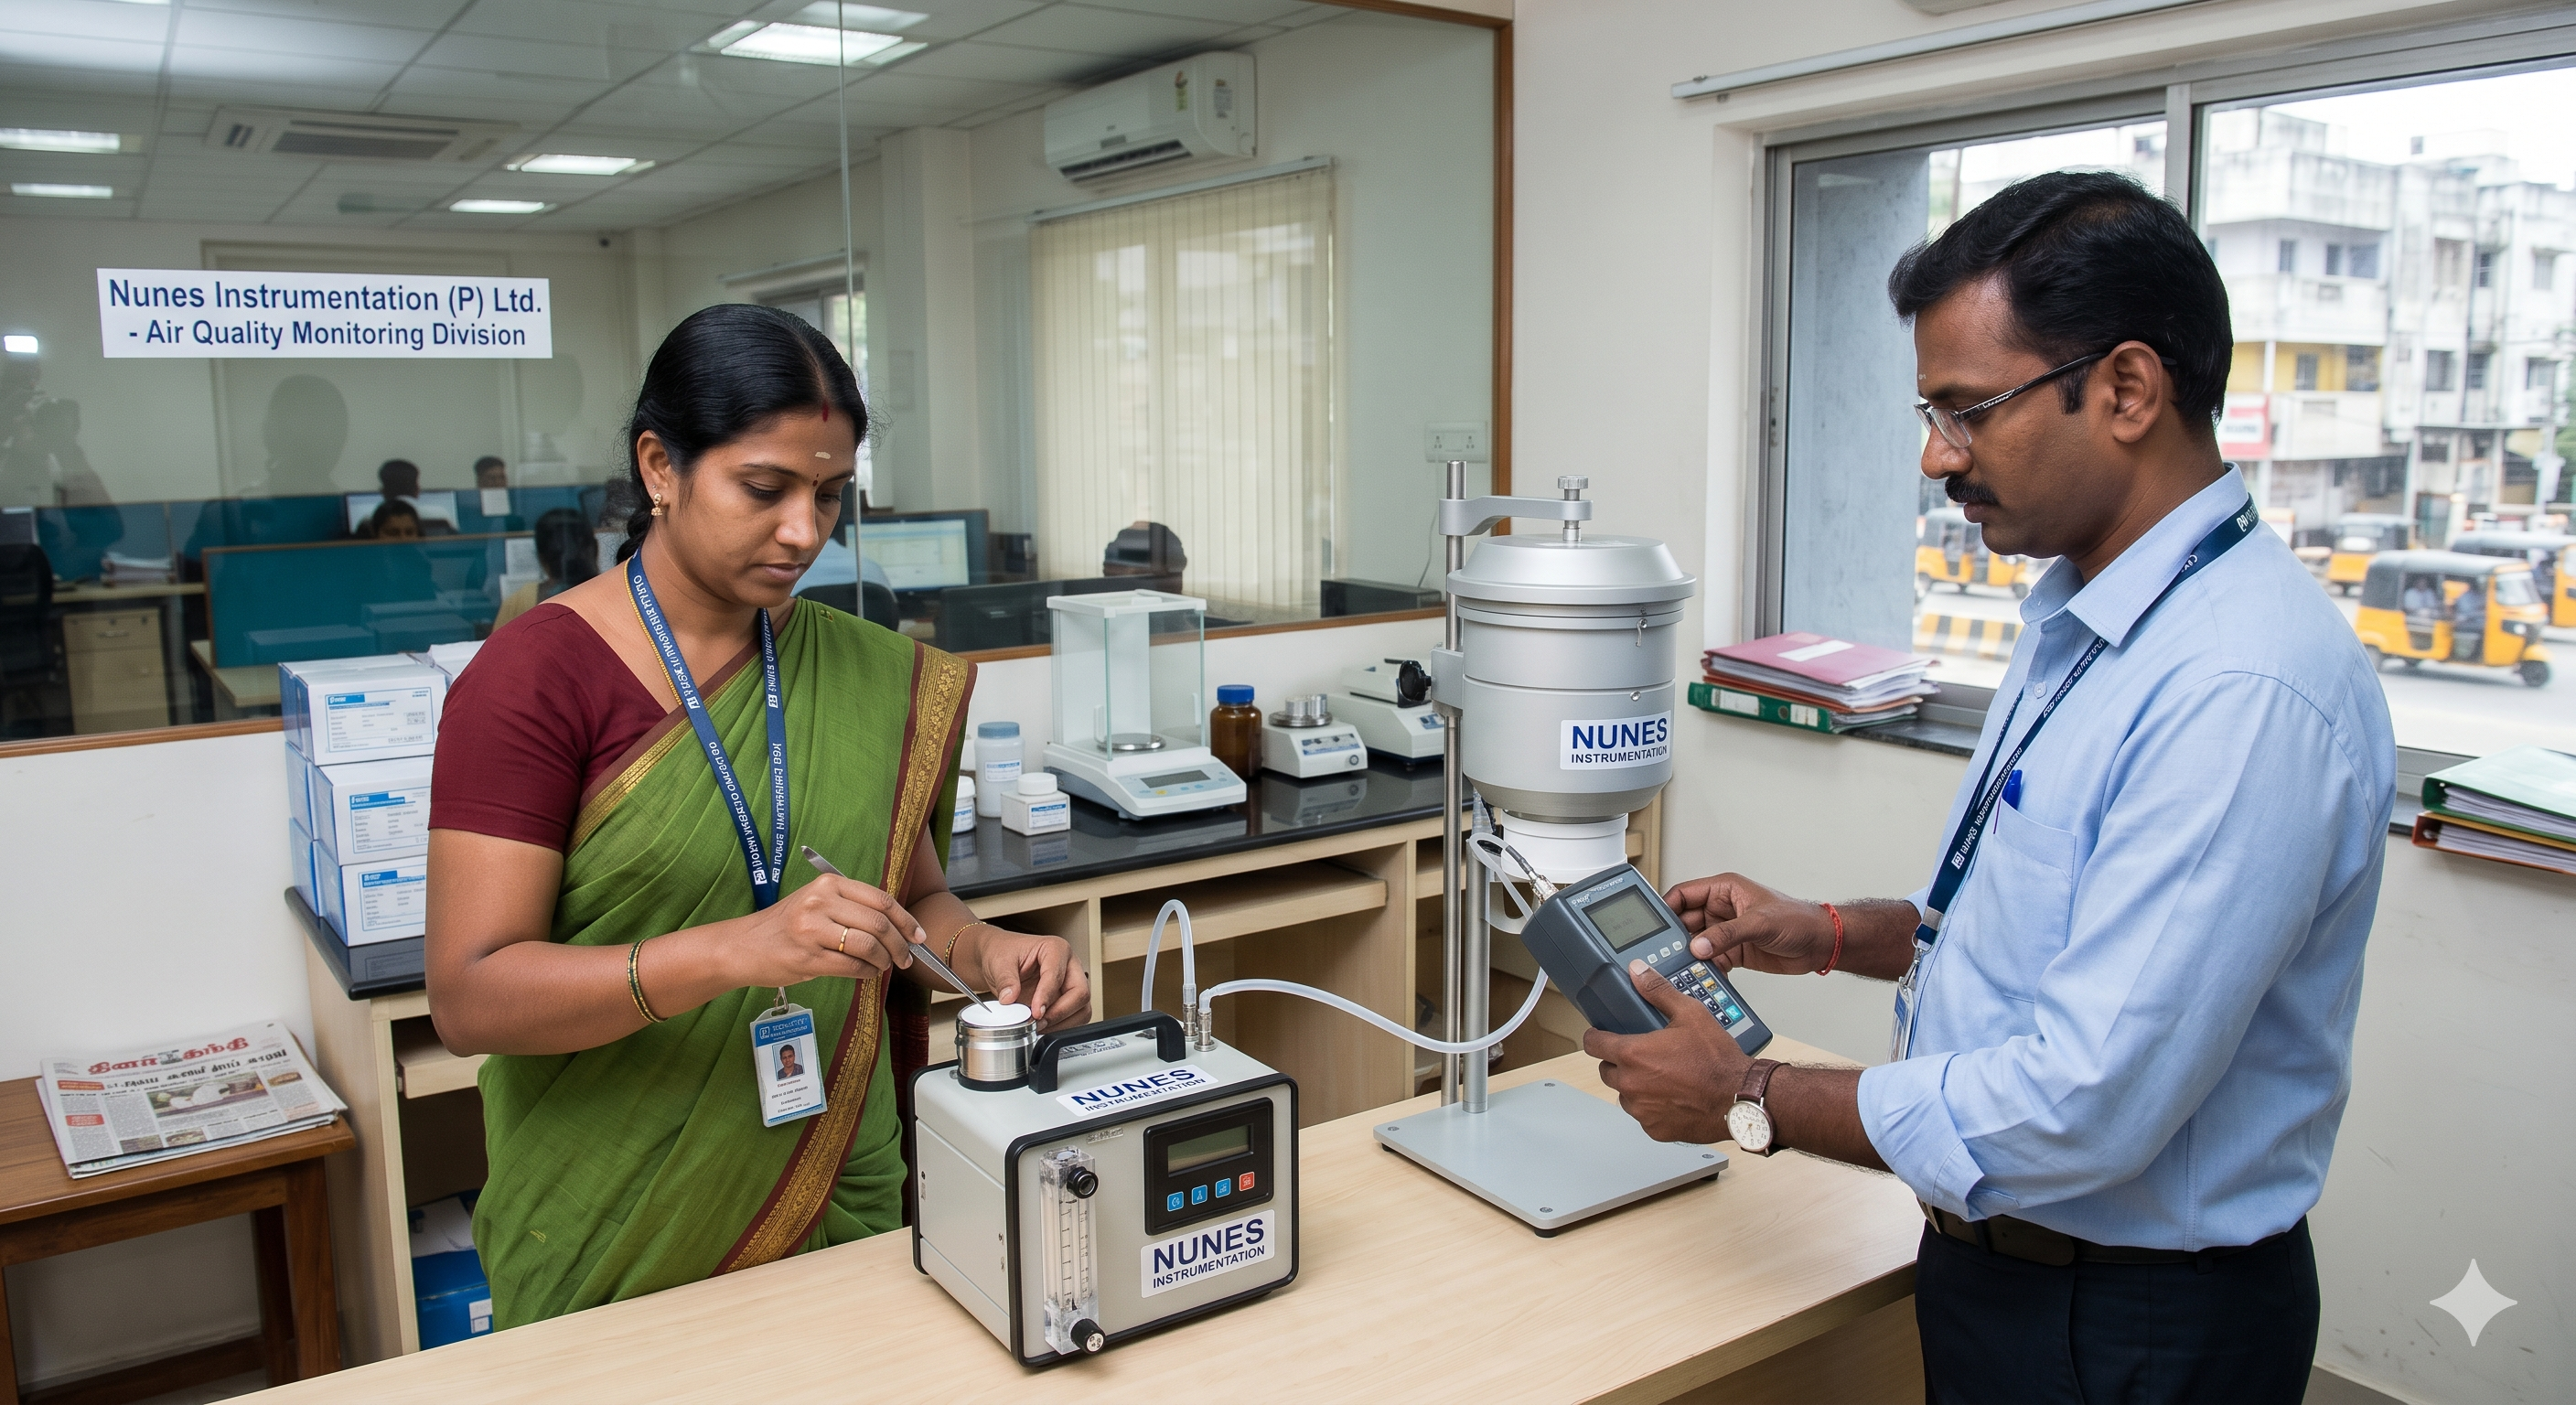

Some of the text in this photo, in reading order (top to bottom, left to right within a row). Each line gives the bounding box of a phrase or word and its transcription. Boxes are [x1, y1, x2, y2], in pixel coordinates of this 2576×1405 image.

[110, 279, 542, 318] Nunes Instrumentation (P) Ltd.
[145, 320, 183, 344] Air
[193, 320, 283, 349] Quality
[293, 320, 424, 350] Monitoring
[433, 323, 525, 345] Division
[1572, 718, 1668, 749] NUNES
[1572, 745, 1668, 763] INSTRUMENTATION
[1071, 1069, 1196, 1105] NUNES
[1154, 1218, 1264, 1274] NUNES
[1153, 1245, 1265, 1289] INSTRUMENTATION
